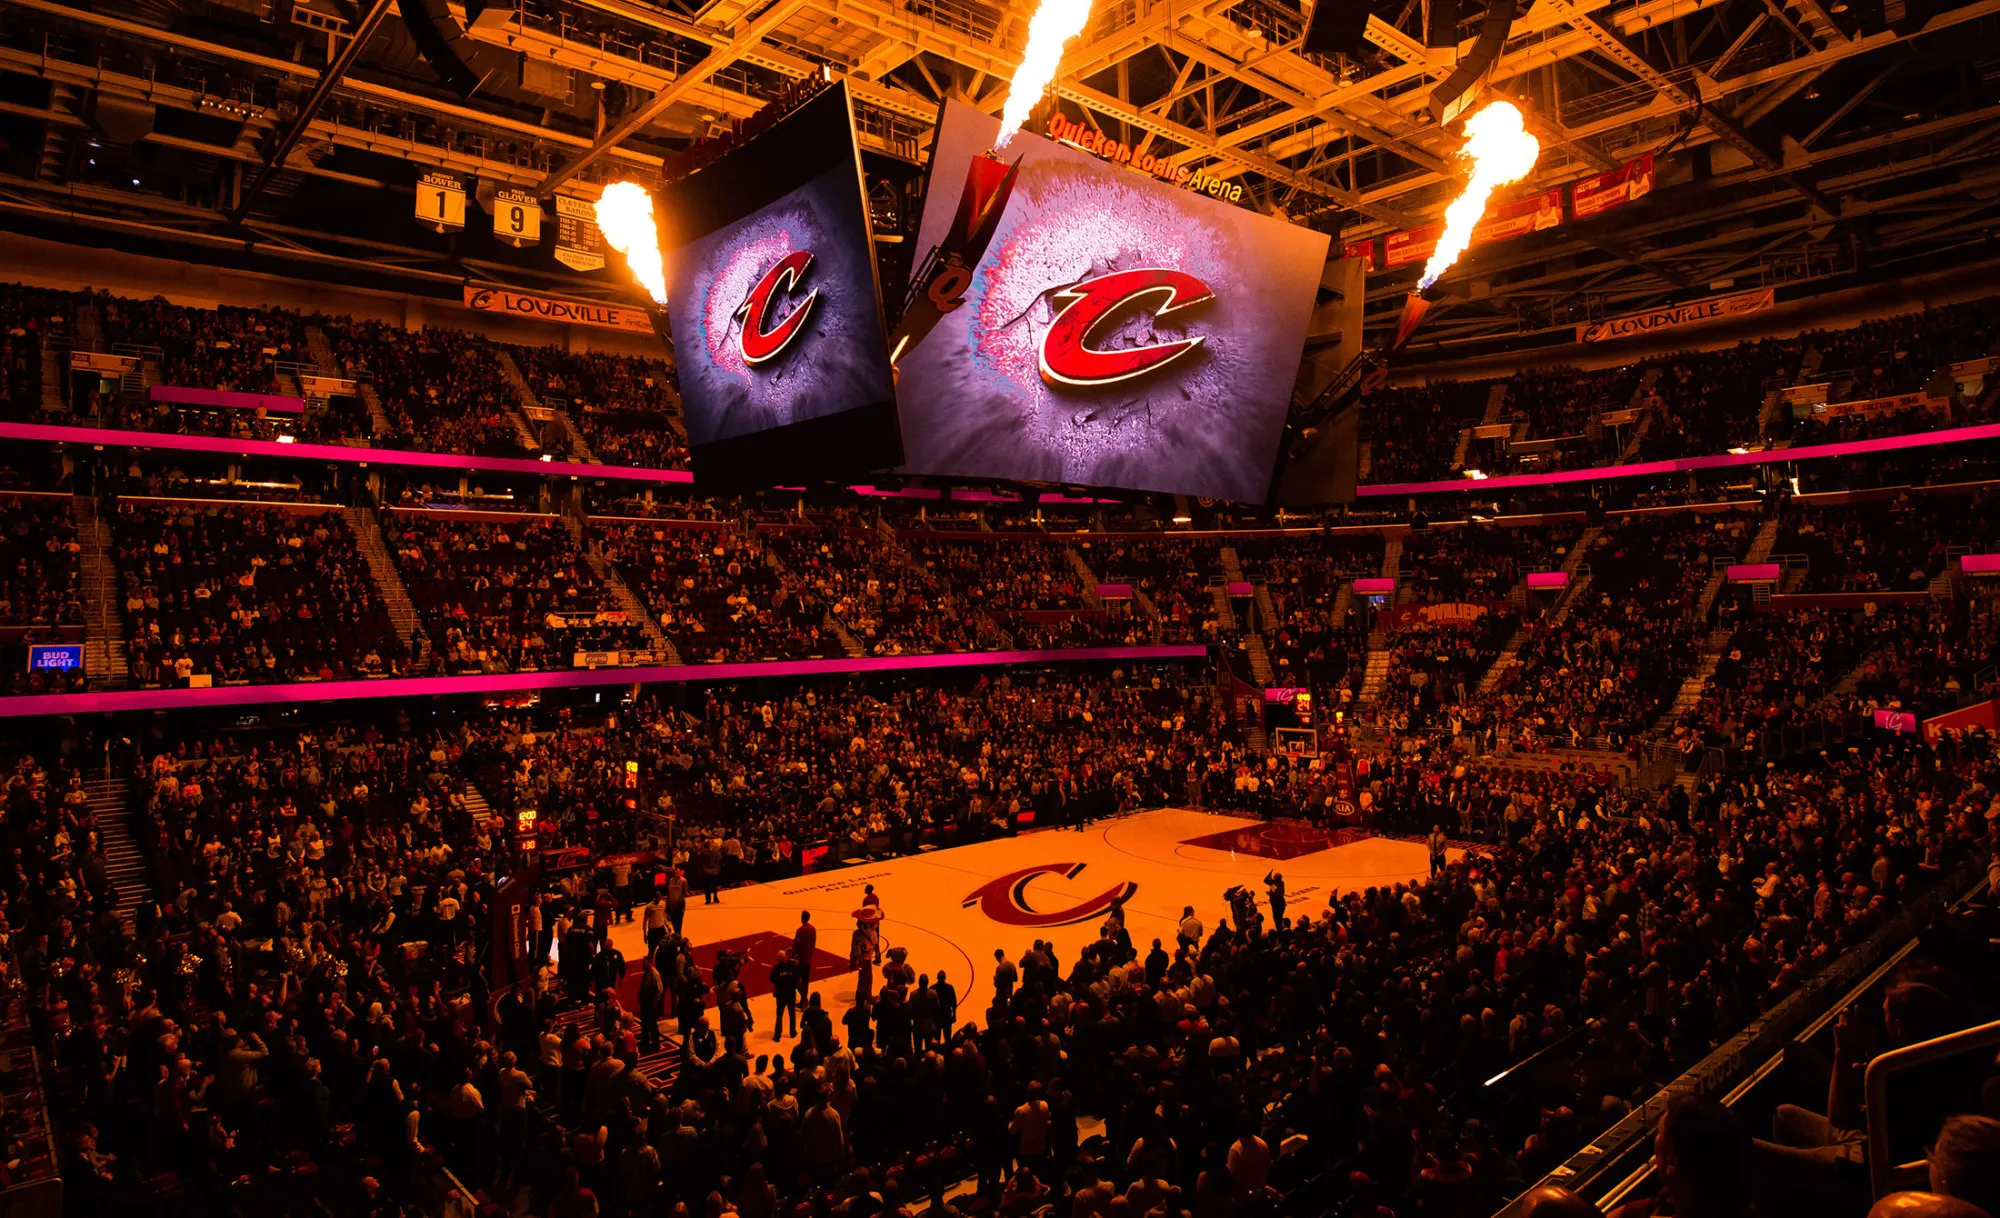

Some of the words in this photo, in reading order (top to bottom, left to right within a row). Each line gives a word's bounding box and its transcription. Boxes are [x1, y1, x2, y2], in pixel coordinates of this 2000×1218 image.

[1049, 112, 1131, 163] Quicken
[1130, 144, 1189, 184] Loans
[1189, 168, 1243, 201] Arena
[423, 174, 462, 189] BOWER
[435, 191, 446, 218] 1
[498, 190, 538, 204] GLOVER
[558, 198, 596, 213] CLEVELA
[510, 206, 524, 232] 9
[504, 294, 621, 325] LOUDVILLE
[1610, 302, 1724, 336] LOUDVILLE
[42, 651, 70, 660] BUD
[37, 659, 74, 668] LIGHT
[519, 820, 533, 831] 24
[782, 881, 846, 895] Quicken
[848, 872, 892, 883] Loans
[825, 881, 869, 893] Arena
